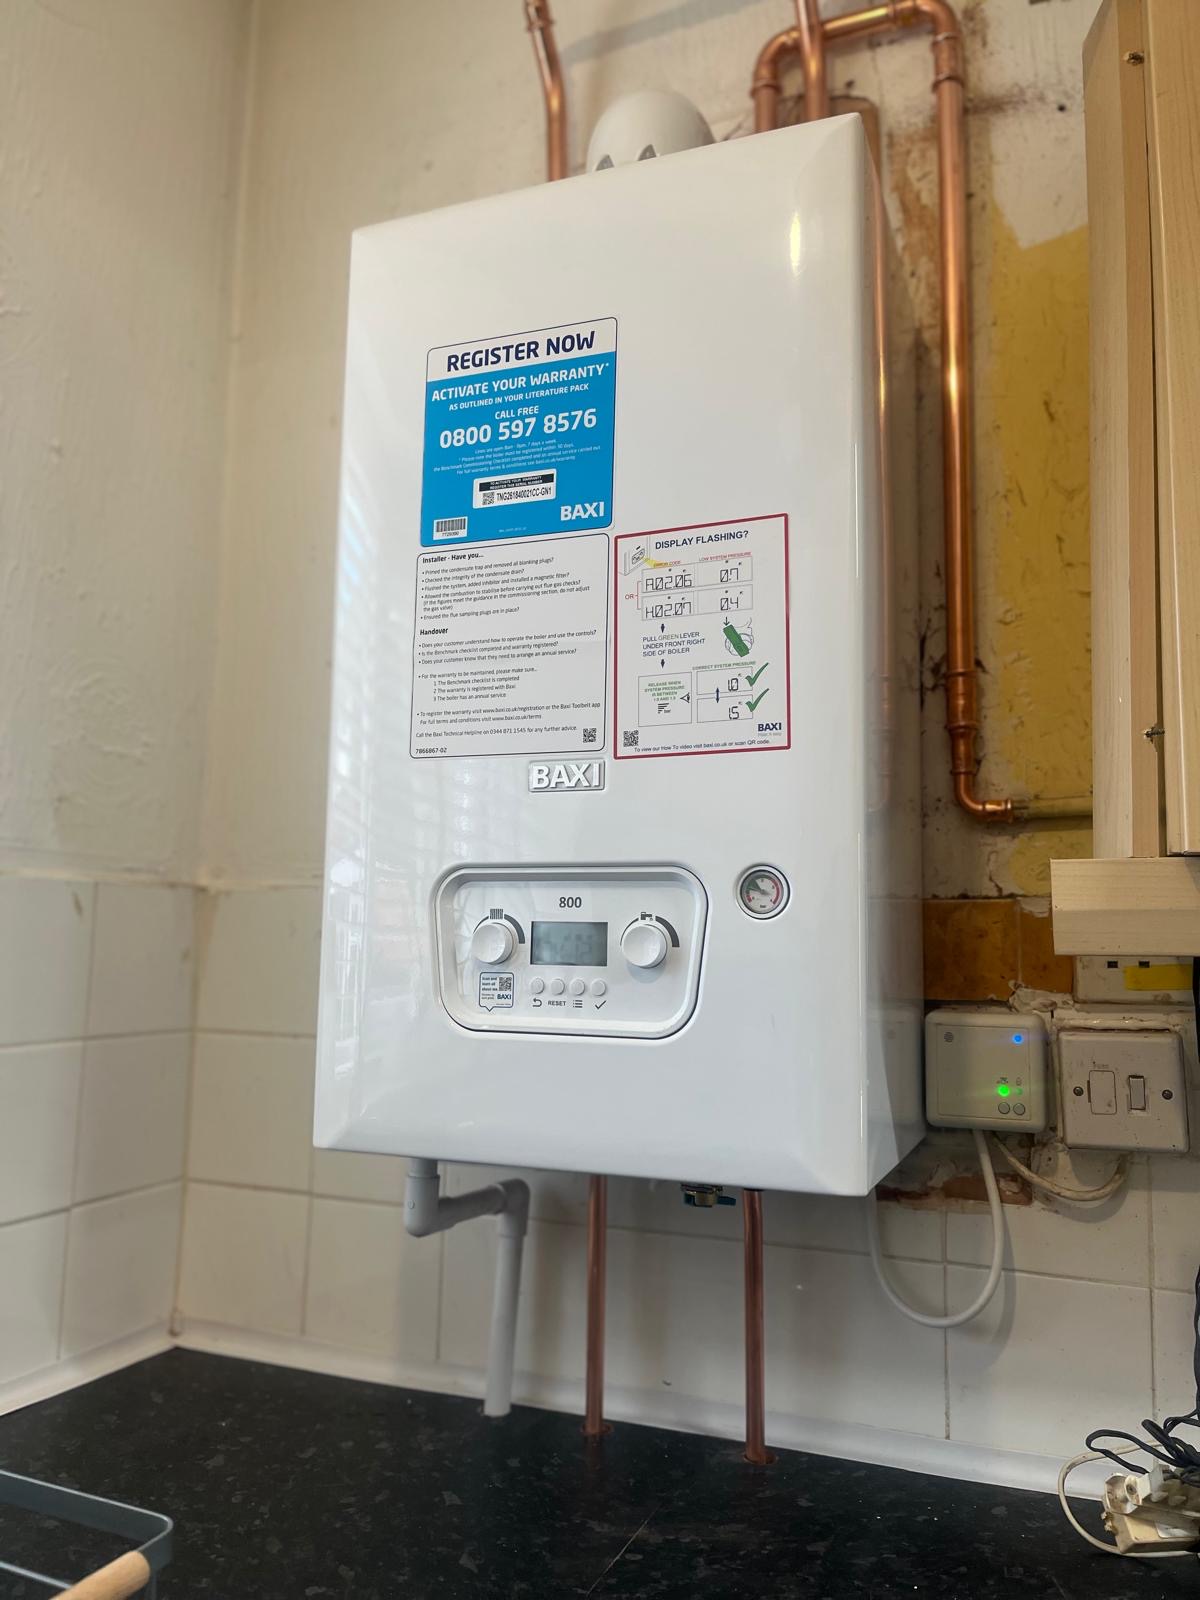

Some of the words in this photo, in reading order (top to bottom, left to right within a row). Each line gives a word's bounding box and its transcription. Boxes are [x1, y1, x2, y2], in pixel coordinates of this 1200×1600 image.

[447, 339, 539, 372] REGISTER
[546, 330, 594, 356] NOW
[432, 381, 488, 401] ACTIVATE
[492, 375, 525, 393] YOUR
[449, 401, 458, 411] AS
[459, 396, 493, 409] OUTLINED
[495, 395, 502, 404] IN
[504, 392, 523, 403] YOUR
[525, 385, 568, 400] LITERATURE
[570, 382, 588, 393] PACK
[494, 408, 515, 419] CALL
[517, 405, 539, 416] FREE
[439, 422, 491, 449] 0800
[498, 416, 536, 441] 597
[543, 407, 596, 435] 8576
[560, 501, 604, 520] BAXI
[655, 537, 693, 550] DISPLAY
[696, 529, 748, 545] FLASHING?
[422, 555, 447, 563] Installer
[451, 552, 466, 560] Have
[720, 596, 738, 610] 0.4
[419, 626, 448, 636] Handover
[657, 633, 678, 641] GREEN
[757, 722, 781, 731] BAXI
[532, 763, 600, 789] BAXI
[559, 897, 582, 908] 800
